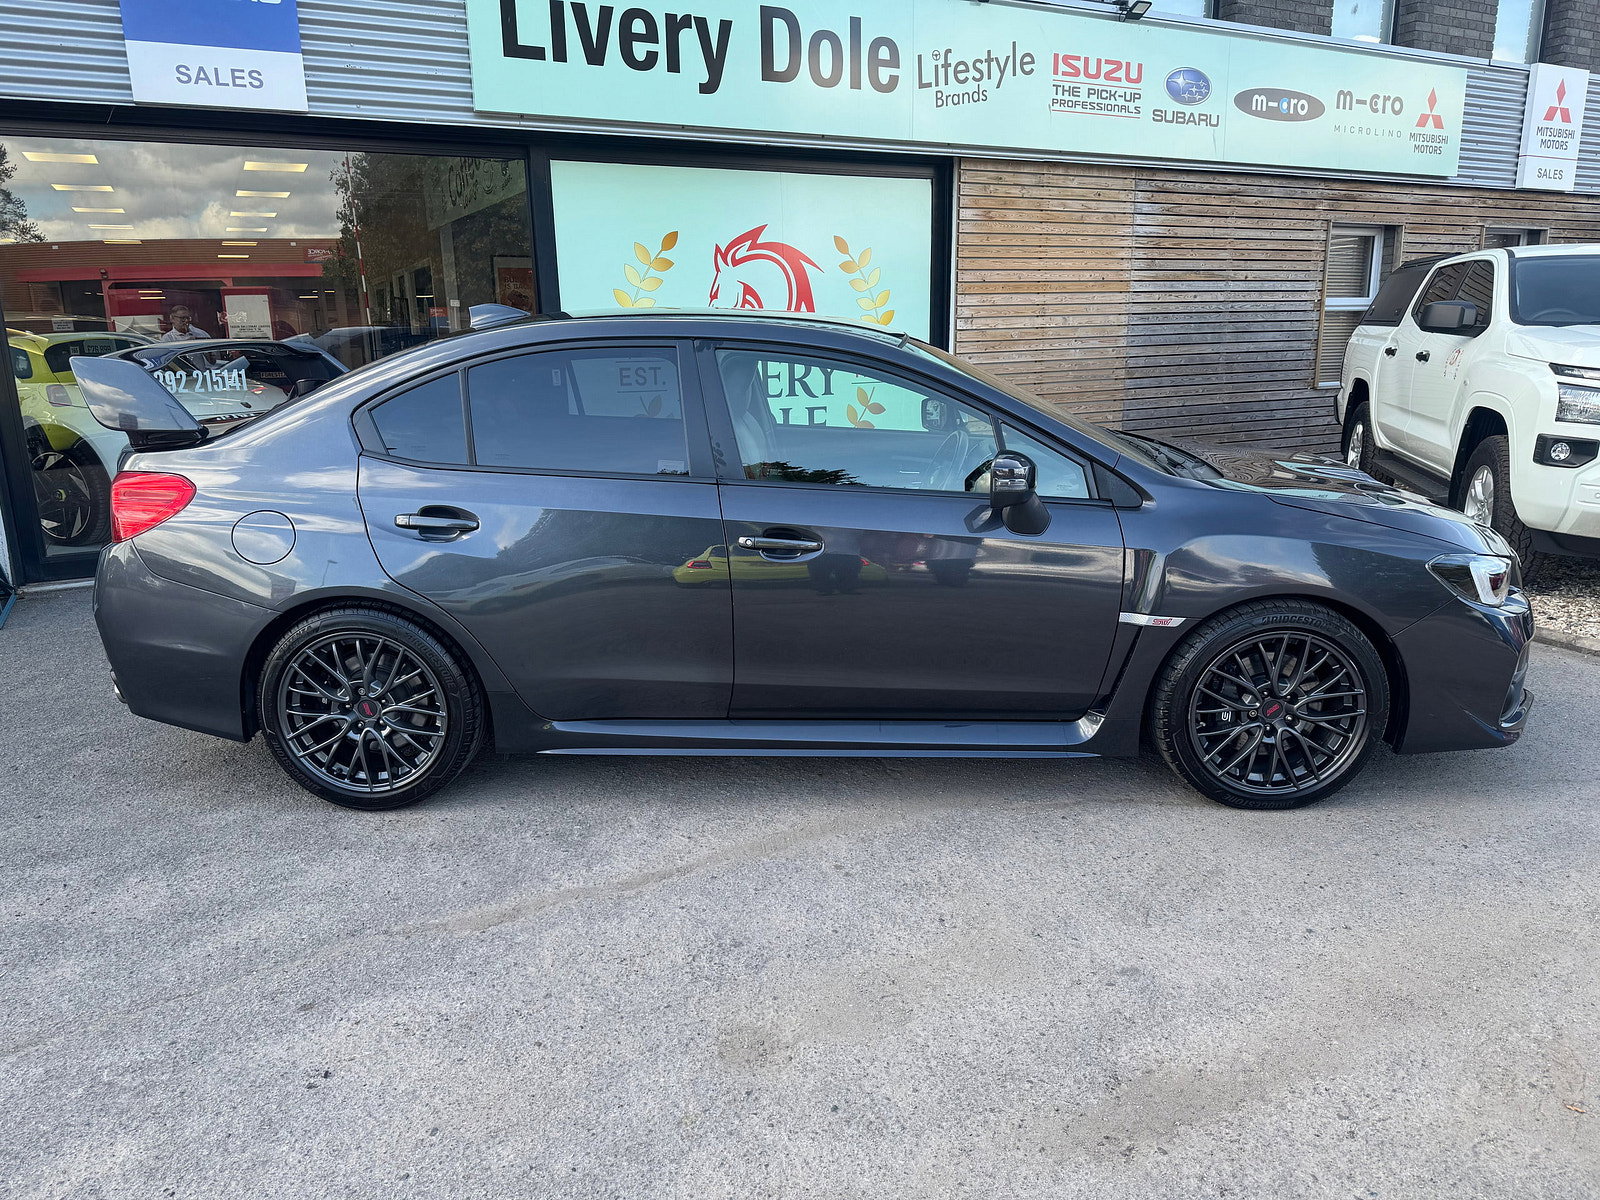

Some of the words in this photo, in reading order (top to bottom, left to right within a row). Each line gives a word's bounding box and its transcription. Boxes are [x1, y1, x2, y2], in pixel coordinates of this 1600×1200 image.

[499, 0, 733, 95] Livery
[759, 4, 900, 94] Dole
[917, 41, 1035, 89] Lifestyle
[1053, 52, 1143, 84] ISUZU
[175, 64, 264, 89] SALES
[935, 84, 988, 108] Brands
[1052, 84, 1081, 98] THE
[1087, 88, 1142, 103] PICK-UP
[1051, 98, 1141, 115] PROFESSIONALS
[1152, 109, 1220, 127] SUBARU
[1333, 124, 1402, 139] MICROLINO
[1409, 132, 1449, 145] MITSUBISHI
[1536, 126, 1576, 139] MITSUBISHI
[1413, 144, 1443, 155] MOTORS
[1540, 138, 1569, 151] MOTORS
[1537, 168, 1564, 181] SALES
[193, 368, 248, 393] 215141
[618, 366, 666, 387] EST.
